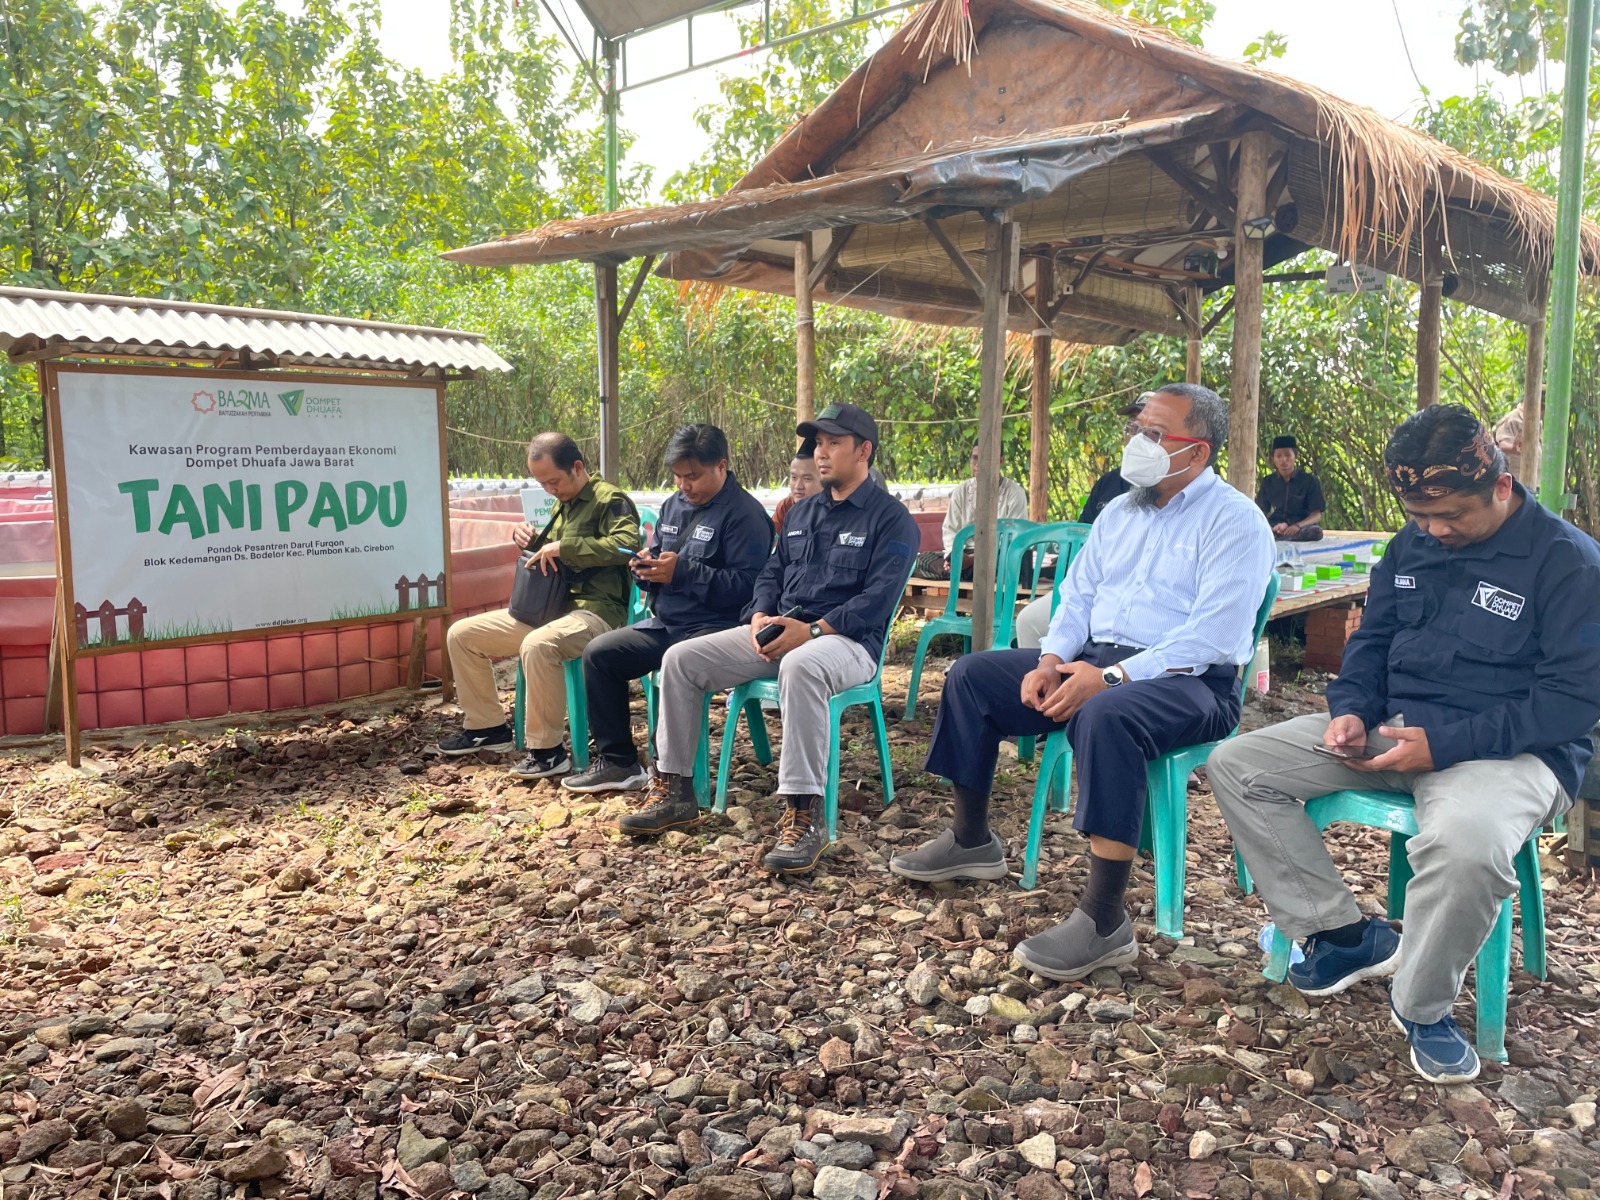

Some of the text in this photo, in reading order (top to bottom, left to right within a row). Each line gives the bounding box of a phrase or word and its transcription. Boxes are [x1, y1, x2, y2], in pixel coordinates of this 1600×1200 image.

[305, 397, 341, 406] DOMPET
[306, 405, 342, 414] DHUAFA
[129, 444, 397, 457] Kawasan Program Pemberdayaan Ekonomi
[186, 457, 355, 470] Dompet Dhuafa Jawa Barat
[118, 478, 408, 540] TANI PADU
[207, 540, 345, 554] Pondok Pesantren Darul Furqon
[144, 543, 395, 567] Blok Kedemangan Ds. Bodelor Kec. Plumbon Kab. Cirebon
[1493, 595, 1521, 611] DOMPET
